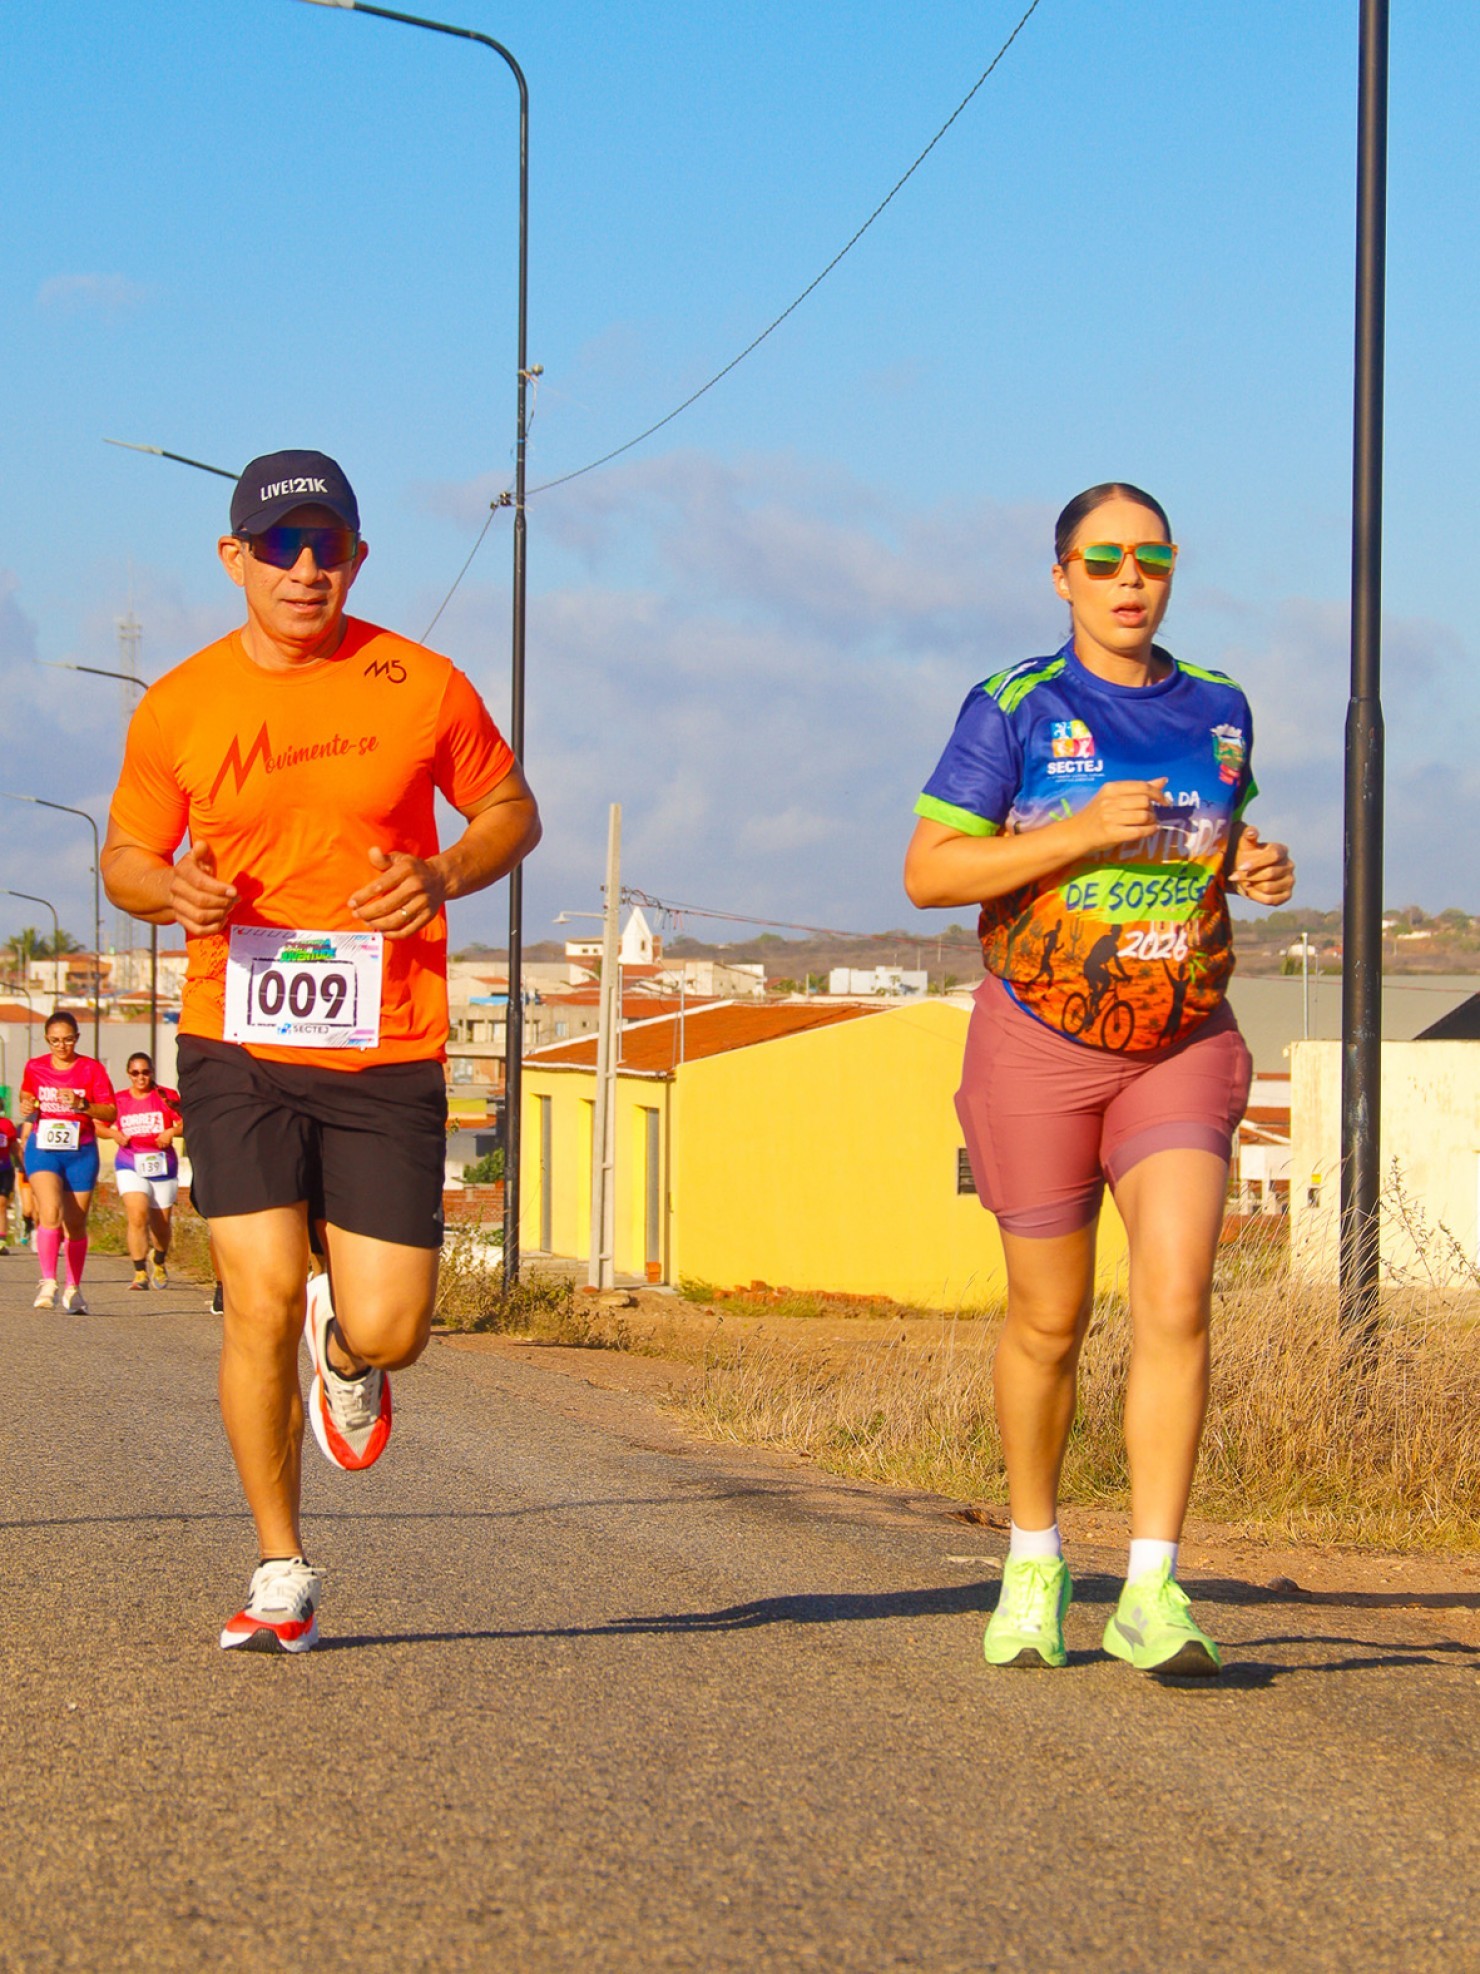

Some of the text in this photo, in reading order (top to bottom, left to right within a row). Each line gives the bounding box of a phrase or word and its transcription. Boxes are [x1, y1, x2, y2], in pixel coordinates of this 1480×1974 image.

[208, 719, 379, 807] Movimente-se
[1047, 760, 1104, 775] SECTEJ
[1066, 882, 1099, 911] DE
[1117, 931, 1189, 962] 2026
[258, 970, 347, 1019] 009
[47, 1131, 70, 1144] 052
